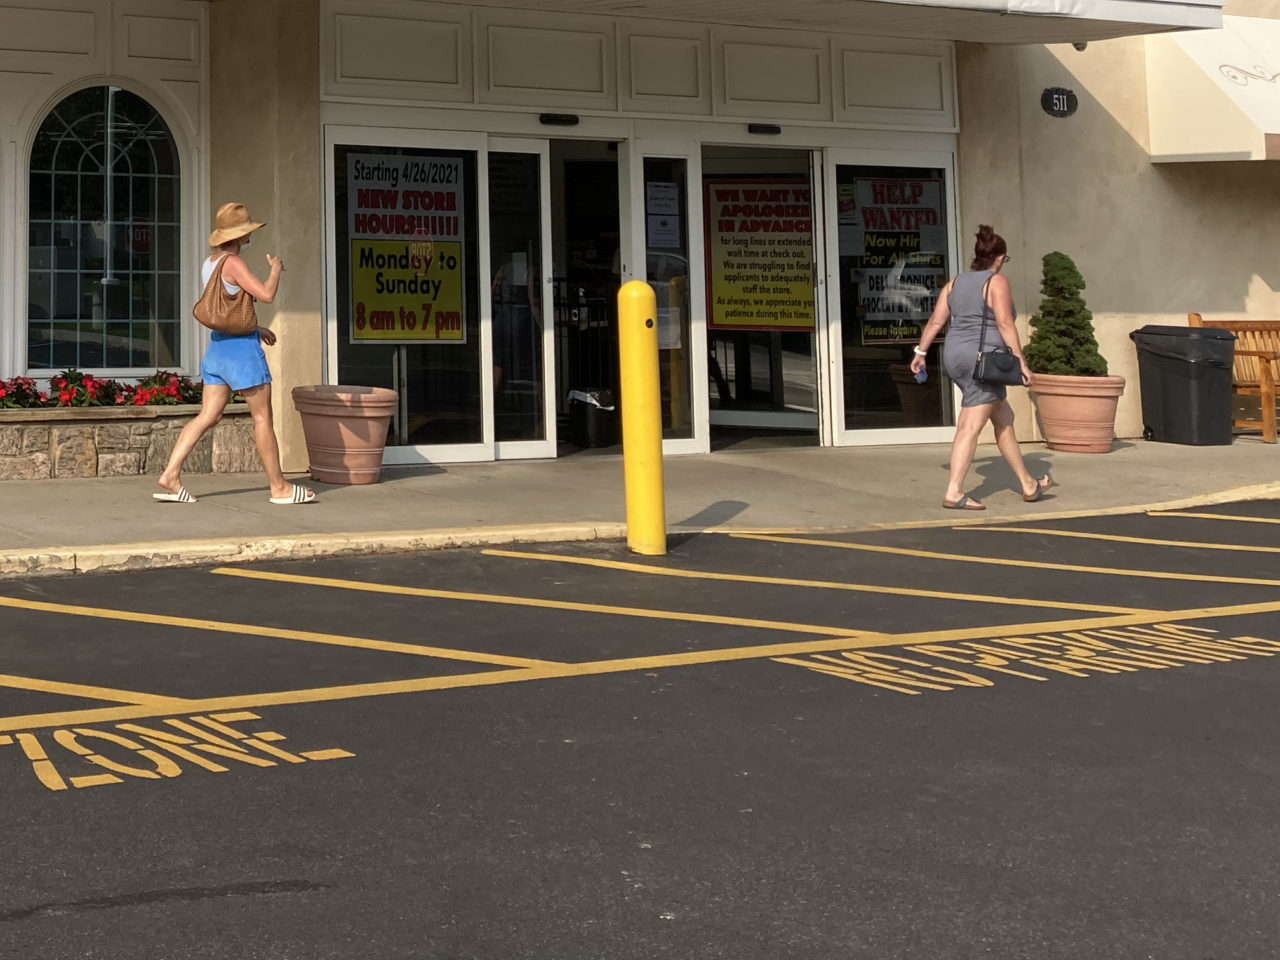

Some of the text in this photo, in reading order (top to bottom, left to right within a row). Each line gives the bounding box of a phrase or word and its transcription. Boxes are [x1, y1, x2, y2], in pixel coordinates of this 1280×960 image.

[1053, 94, 1068, 111] 511
[354, 159, 458, 187] Starting 4/26/2021
[357, 188, 457, 211] NEW STORE
[714, 189, 739, 202] WE
[742, 189, 789, 202] WANT
[871, 181, 923, 205] HELP
[720, 204, 810, 218] APOLOGIZE
[861, 206, 938, 230] WANTED
[718, 219, 735, 232] IN
[720, 235, 811, 248] for long lines or extended
[864, 233, 897, 248] Now
[358, 246, 457, 274] Monday to
[726, 249, 742, 258] wait
[744, 249, 760, 258] time
[761, 249, 768, 258] at
[769, 249, 790, 258] check
[863, 251, 886, 265] For
[723, 260, 811, 272] We are struggling to find
[724, 272, 810, 285] applicants to adequately
[869, 274, 888, 291] DEL
[375, 272, 442, 301] Sunday
[742, 284, 792, 295] staff the store.
[716, 296, 725, 305] As
[753, 298, 763, 306] we
[765, 297, 802, 309] appreciate
[356, 302, 460, 339] 8 am to 7 pm
[724, 308, 754, 319] patience
[755, 309, 779, 320] during
[780, 309, 793, 319] this
[863, 324, 888, 337] Please
